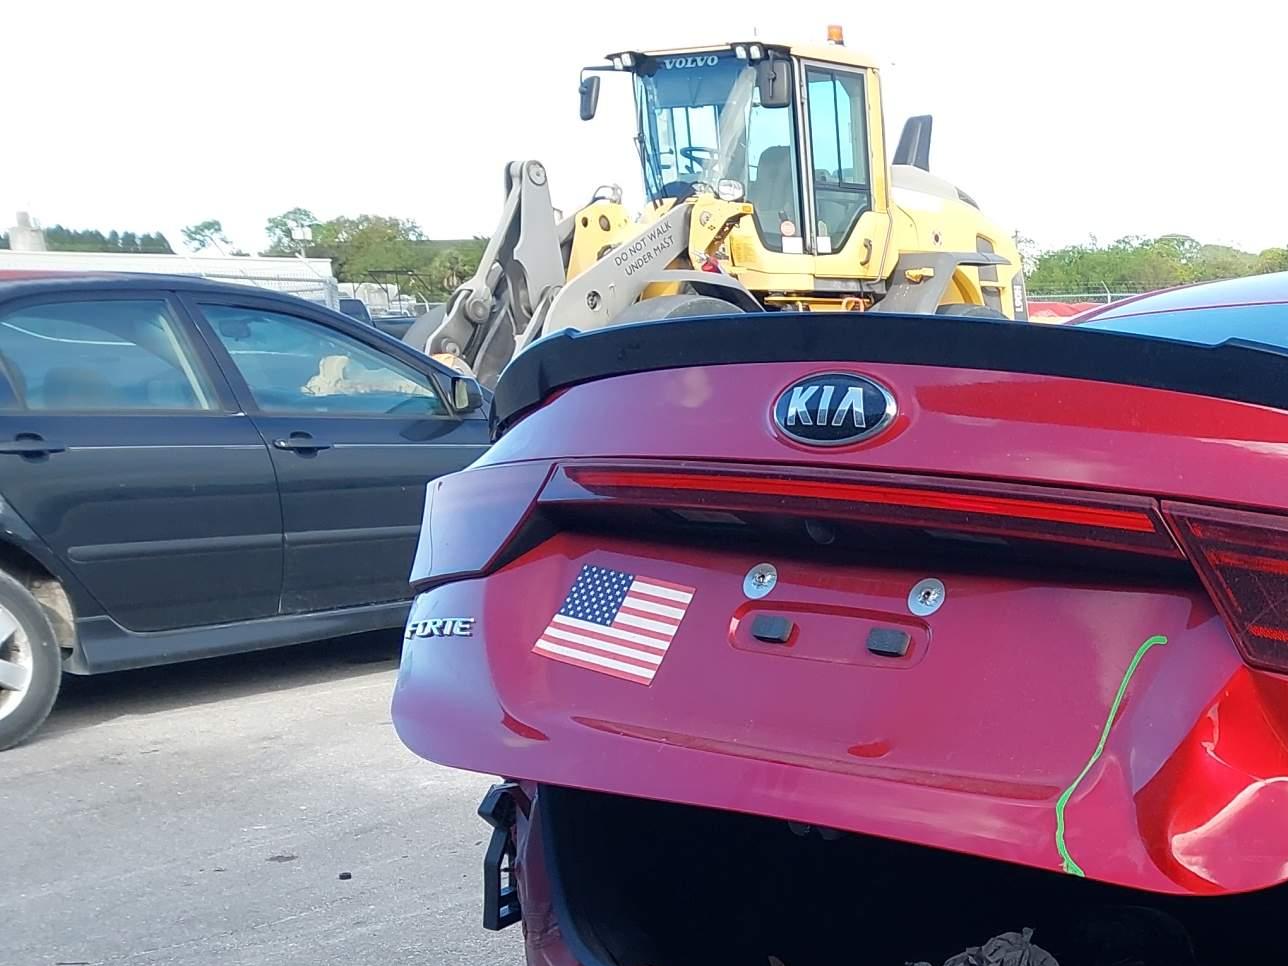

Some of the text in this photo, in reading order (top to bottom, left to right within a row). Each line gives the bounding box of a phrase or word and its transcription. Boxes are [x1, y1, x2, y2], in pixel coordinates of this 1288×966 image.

[663, 55, 719, 70] VOLVO
[614, 220, 672, 266] DO NOT WALK
[624, 235, 674, 276] UNDER MAST
[786, 385, 867, 428] KIA
[404, 617, 475, 640] FORTE
